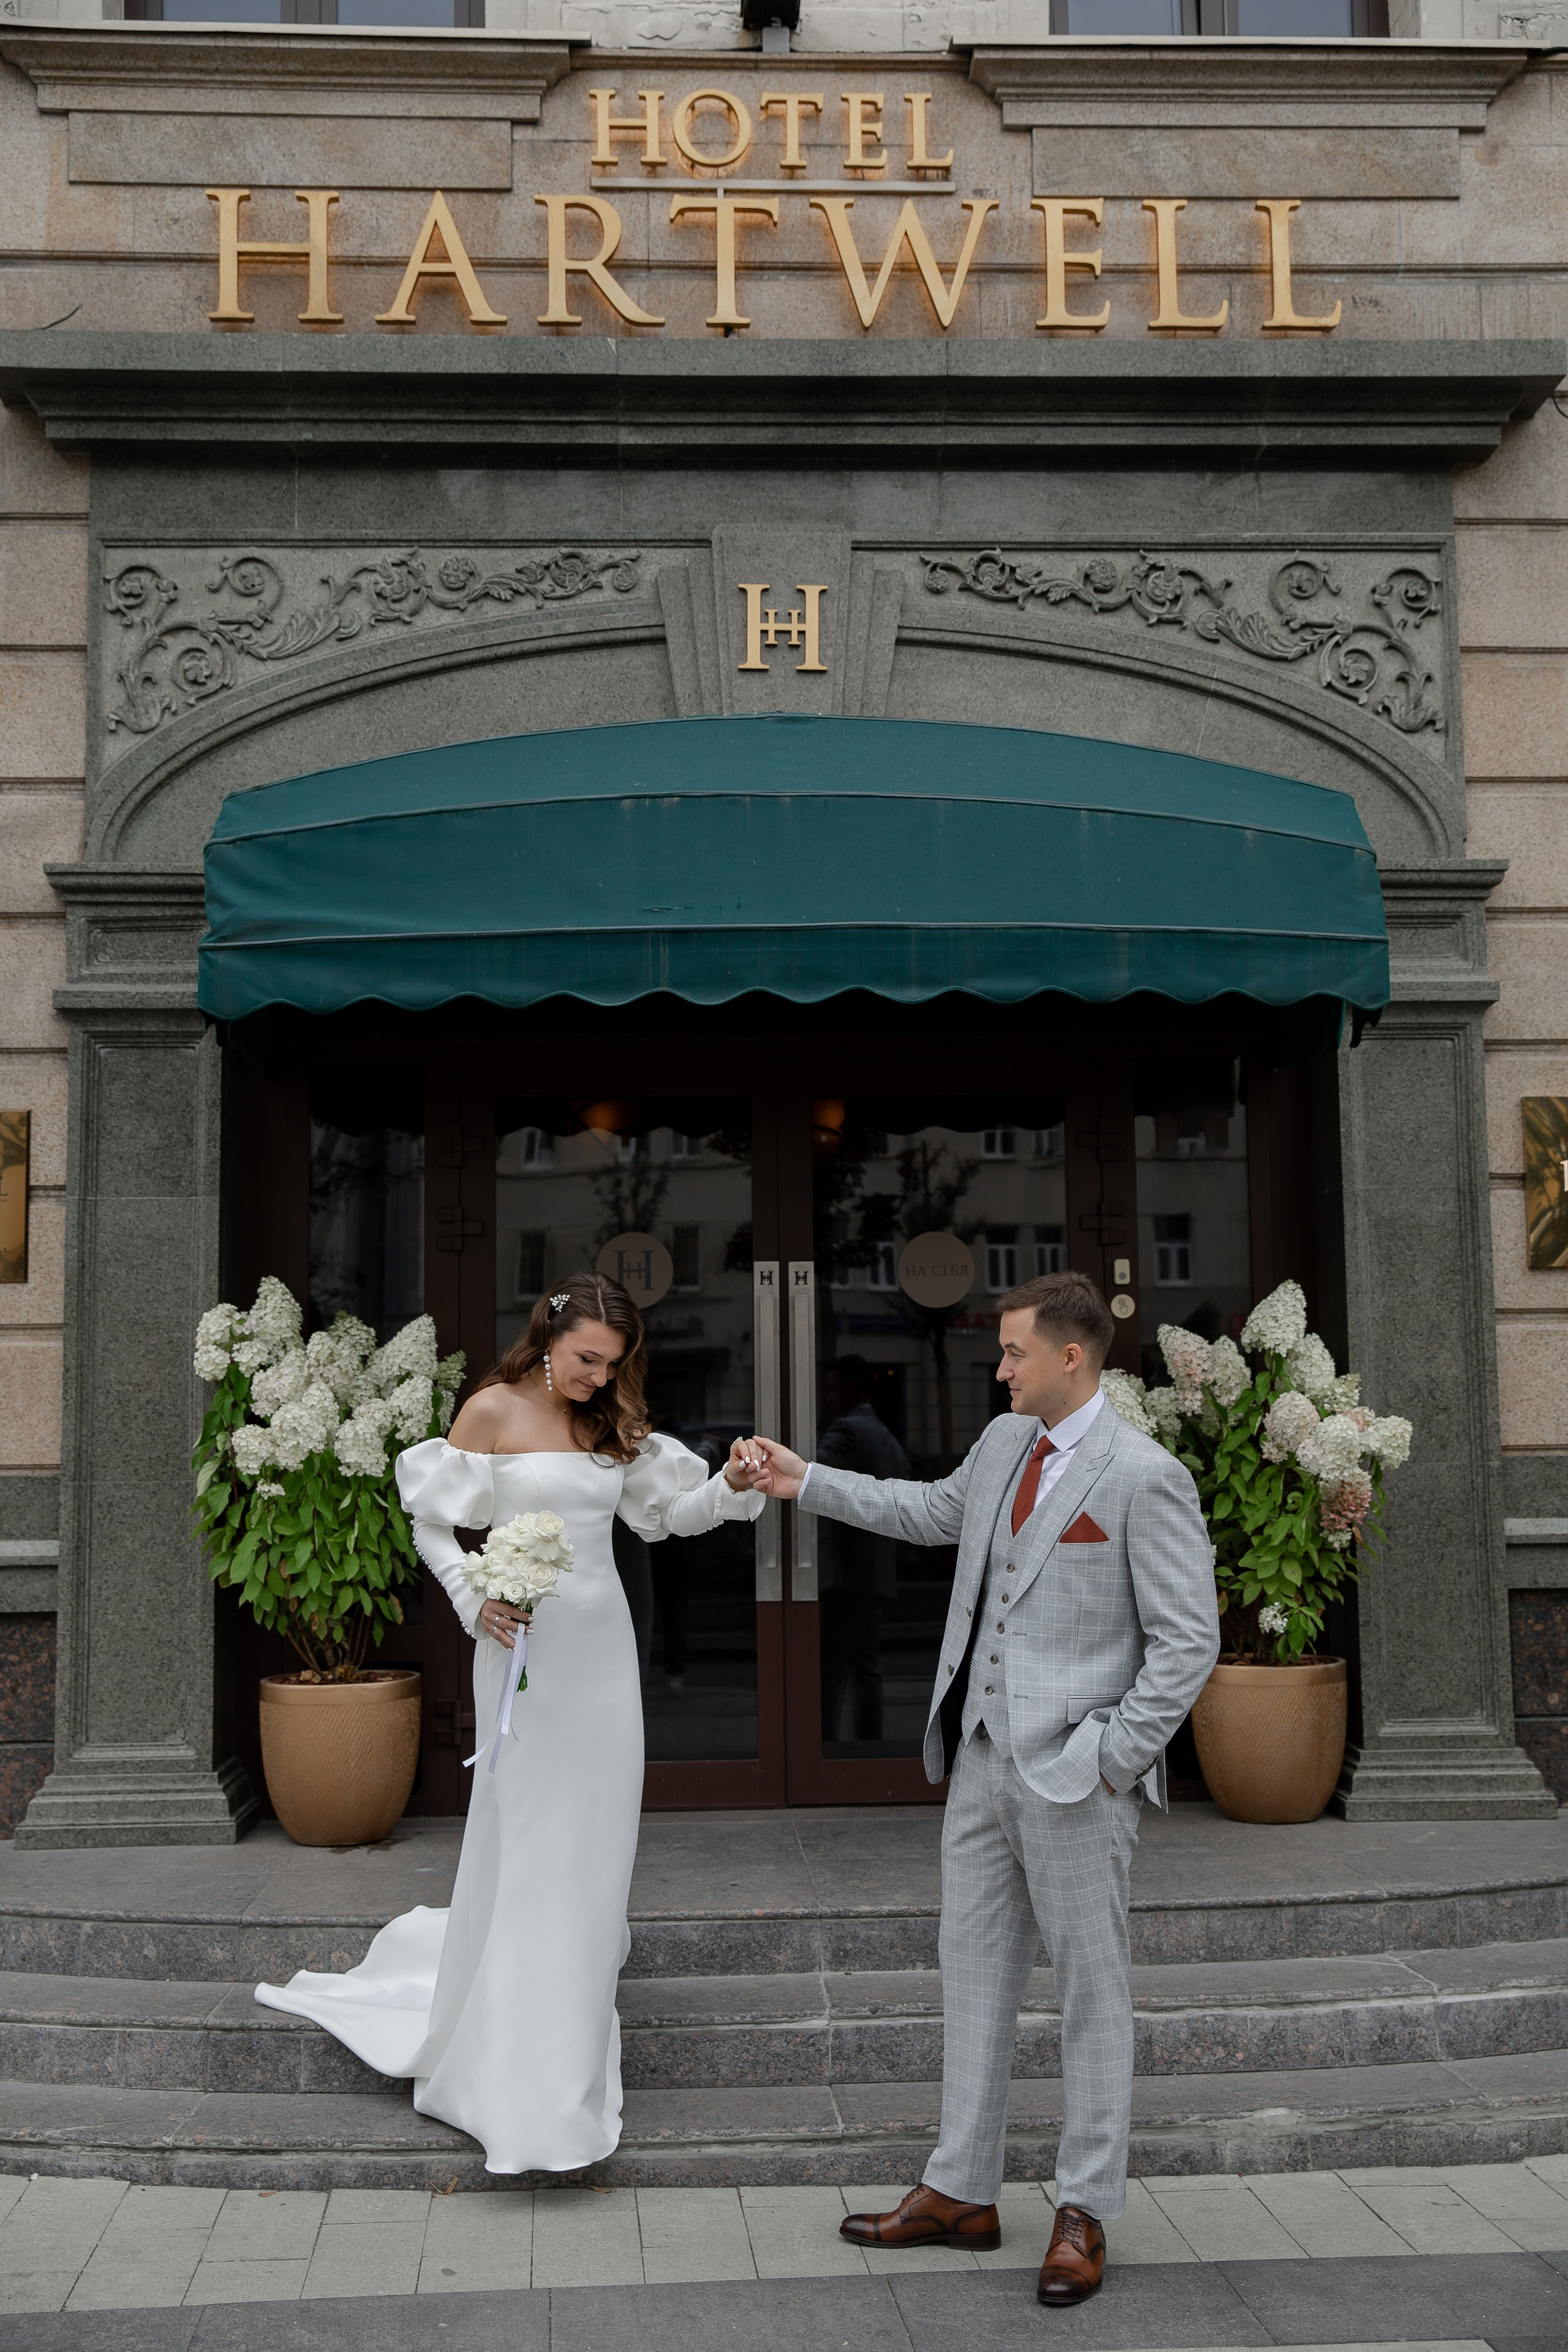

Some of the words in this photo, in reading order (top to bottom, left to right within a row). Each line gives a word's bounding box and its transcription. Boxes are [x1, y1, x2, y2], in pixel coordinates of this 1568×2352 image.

[588, 88, 954, 169] HOTEL
[205, 189, 1343, 330] HARTWELL
[905, 1265, 927, 1277] НА
[931, 1264, 968, 1276] СЕБЯ
